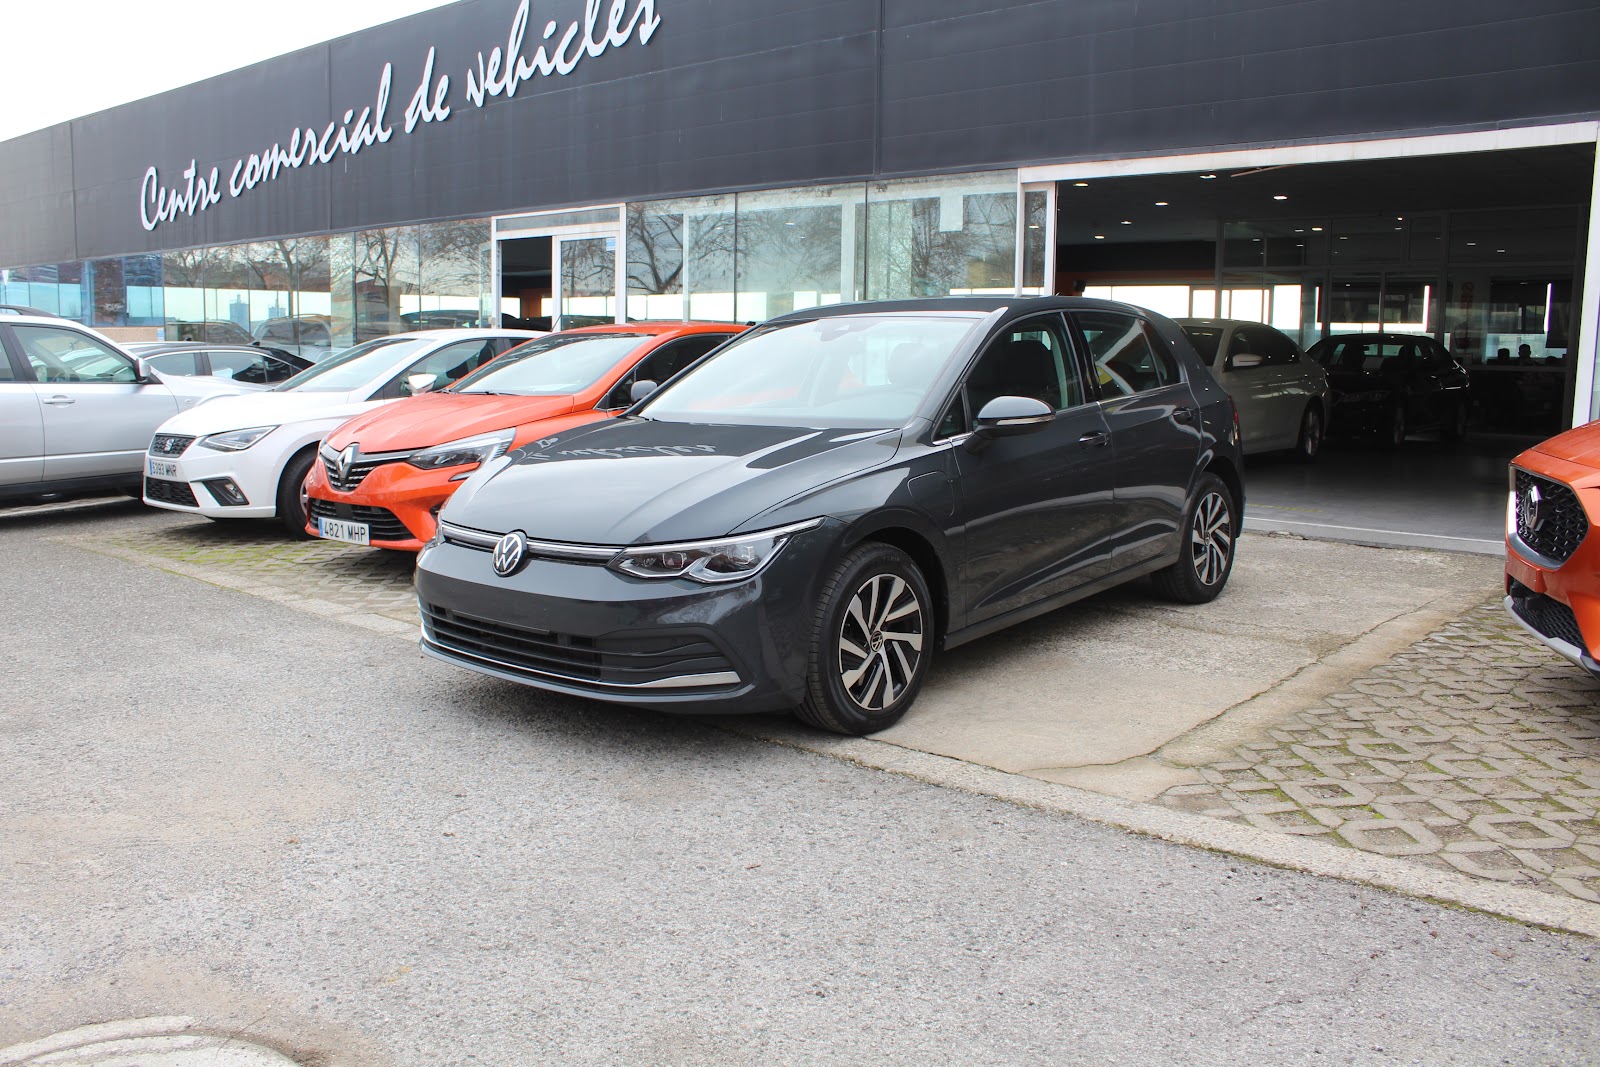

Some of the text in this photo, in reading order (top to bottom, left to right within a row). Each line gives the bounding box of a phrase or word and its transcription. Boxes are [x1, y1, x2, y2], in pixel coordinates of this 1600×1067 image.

[140, 0, 661, 231] Centre comercial de vehicles
[324, 521, 366, 542] 4821 MHP
